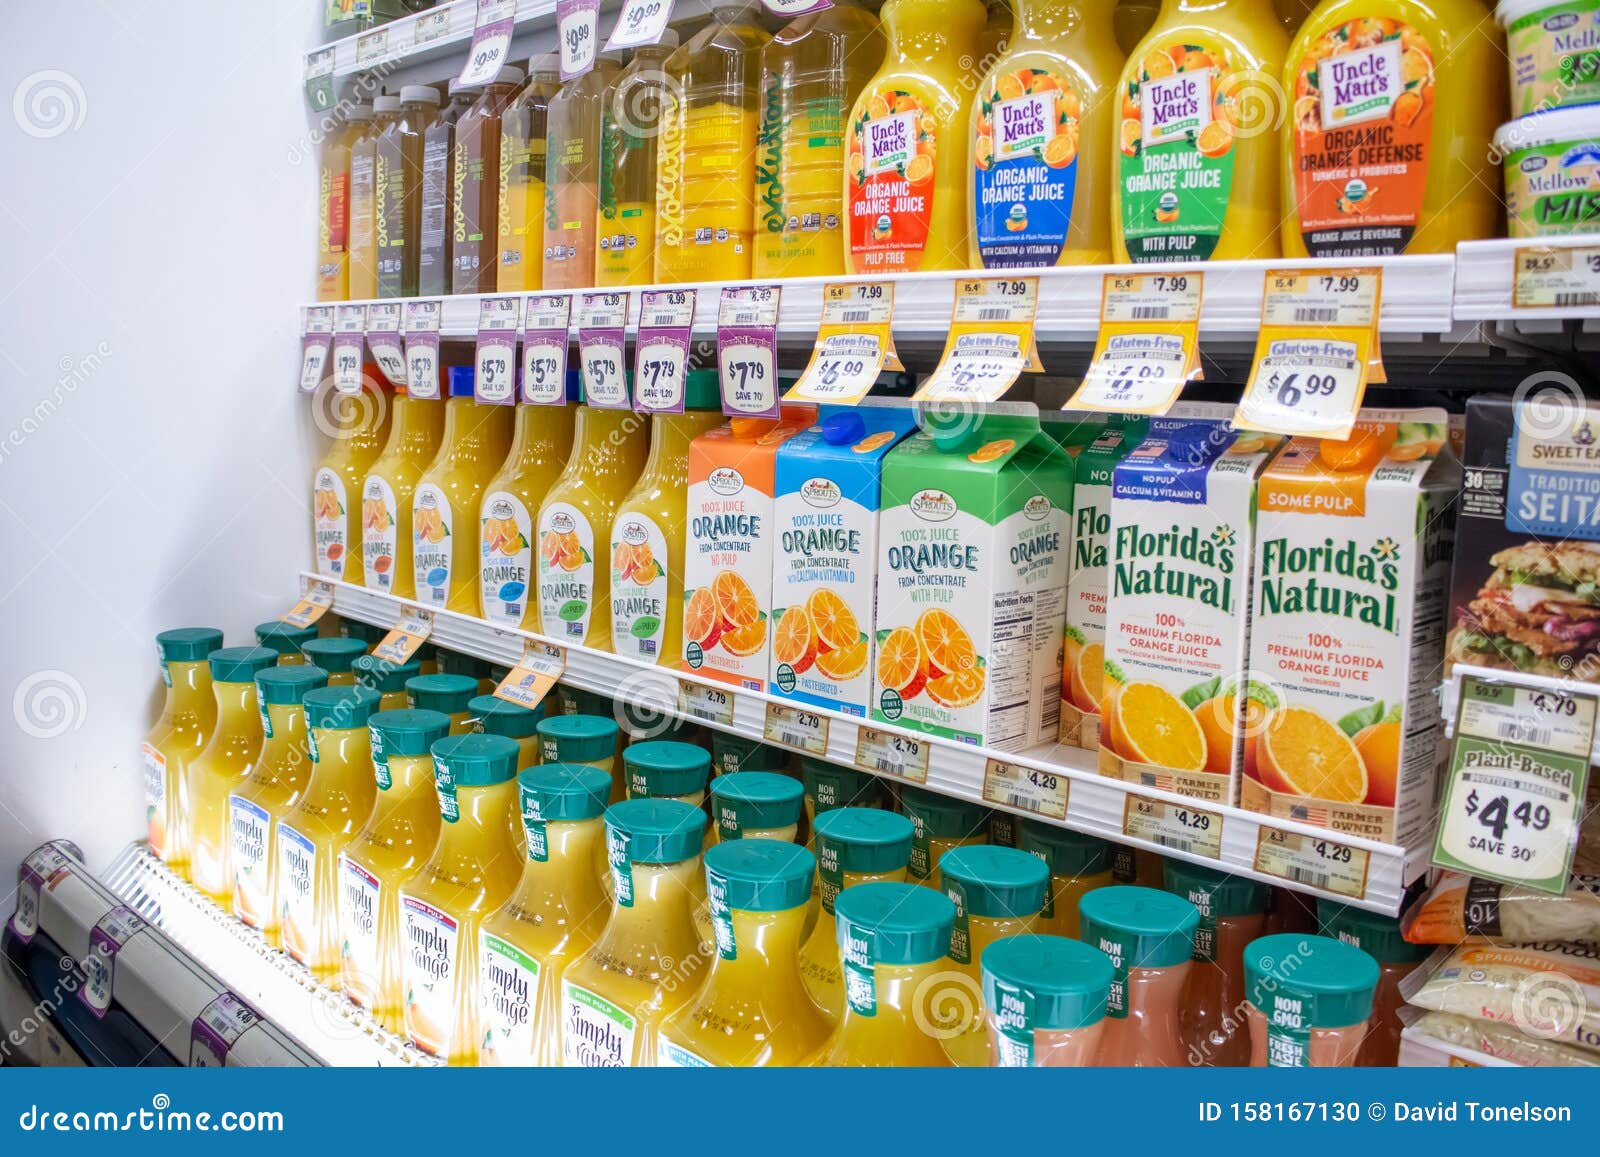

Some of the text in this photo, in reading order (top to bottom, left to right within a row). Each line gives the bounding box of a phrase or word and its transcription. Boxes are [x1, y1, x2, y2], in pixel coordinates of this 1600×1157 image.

[1332, 54, 1385, 84] Uncle
[1152, 79, 1196, 105] Uncle
[1334, 75, 1388, 106] Matt's
[1003, 100, 1042, 124] Uncle
[1153, 98, 1198, 125] Matt's
[872, 119, 904, 141] Uncle
[1004, 119, 1044, 142] Matt's
[1324, 126, 1394, 150] ORGANIC
[755, 73, 791, 232] evolution
[872, 135, 906, 158] Matt's
[1144, 152, 1202, 172] ORGANIC
[1301, 144, 1423, 172] ORANGE DEFENSE
[995, 167, 1048, 184] ORGANIC
[1360, 164, 1407, 176] PROBIOTICS
[866, 182, 909, 197] ORGANIC
[1127, 170, 1221, 193] ORANGE JUICE
[1528, 173, 1589, 193] Mellow
[982, 184, 1064, 203] ORANGE JUICE
[855, 197, 924, 215] ORANGE JUICE
[994, 246, 1057, 255] CALCIUM VITAMIN D
[1143, 236, 1196, 251] WITH PULP
[865, 252, 904, 264] PULP FREE
[858, 287, 882, 298] $7.99
[998, 282, 1025, 295] $7.99
[1154, 278, 1186, 291] $7.99
[1321, 277, 1359, 292] $7.99
[482, 359, 505, 384] $579
[531, 359, 556, 384] $579
[588, 359, 615, 386] $579
[644, 360, 674, 388] $779
[729, 361, 764, 389] $779
[819, 361, 863, 385] $699
[644, 389, 658, 397] SAVE
[736, 391, 751, 400] SAVE
[1268, 371, 1336, 406] $699
[711, 475, 741, 487] SPROUTS
[1091, 471, 1107, 480] NO
[1142, 475, 1155, 483] NO
[1464, 471, 1482, 488] 30
[804, 487, 838, 499] SPROUTS
[1117, 485, 1201, 499] CALCIUM VITAMIN D
[702, 501, 744, 513] 100% JUICE
[914, 499, 953, 511] SPROUTS
[1268, 492, 1354, 510] SOME PULP
[693, 514, 761, 540] ORANGE
[792, 514, 843, 527] 100% JUICE
[782, 529, 860, 556] ORANGE
[900, 529, 959, 542] 100% JUICE
[700, 542, 750, 552] FROM CONCENTRATE
[1010, 533, 1059, 565] ORANGE
[416, 554, 448, 568] ORANGE
[712, 555, 737, 565] NO PULP
[791, 558, 849, 569] FROM CONCENTRATE
[888, 544, 979, 574] ORANGE
[483, 566, 525, 583] ORANGE
[898, 575, 966, 588] FROM CONCENTRATE
[542, 583, 587, 602] ORANGE
[1114, 561, 1232, 613] Natural
[910, 589, 954, 603] WITH PULP
[994, 595, 1033, 608] Nutrition Facts
[614, 599, 660, 617] ORANGE
[1260, 577, 1396, 633] Natural
[1155, 613, 1185, 628] 100%
[1120, 623, 1221, 647] PREMIUM FLORIDA
[1308, 633, 1342, 648] 100%
[1130, 638, 1208, 658] ORANGE JUICE
[1267, 644, 1384, 670] PREMIUM FLORIDA
[1148, 662, 1182, 673] CONCENTRATE
[1278, 659, 1369, 681] ORANGE JUICE
[543, 741, 557, 751] NON
[544, 750, 558, 760] GMO
[723, 753, 738, 764] NON
[1465, 751, 1572, 788] Plant-Based
[632, 774, 647, 785] NON
[1027, 772, 1056, 790] $4.29
[1175, 777, 1221, 789] FARMER
[632, 784, 647, 795] GMO
[818, 783, 834, 794] NON
[1176, 787, 1221, 800] OWNED
[526, 798, 540, 811] NON
[818, 794, 835, 805] GMO
[721, 808, 736, 821] NON
[1175, 810, 1210, 830] $4.29
[1332, 811, 1383, 824] FARMER
[1465, 789, 1550, 839] $449
[721, 819, 737, 831] GMO
[1332, 821, 1383, 835] OWNED
[822, 846, 837, 860] NON
[1312, 840, 1352, 863] $4.29
[1468, 836, 1504, 855] SAVE
[821, 857, 837, 872] GMO
[1189, 890, 1210, 904] NON
[1100, 937, 1121, 956] NON
[1476, 952, 1554, 970] SPAGHETTI
[1001, 993, 1025, 1014] NON
[1274, 996, 1301, 1014] NON
[1000, 1009, 1026, 1028] GMO
[1273, 1010, 1302, 1028] GMO
[1269, 1037, 1303, 1055] FRESH
